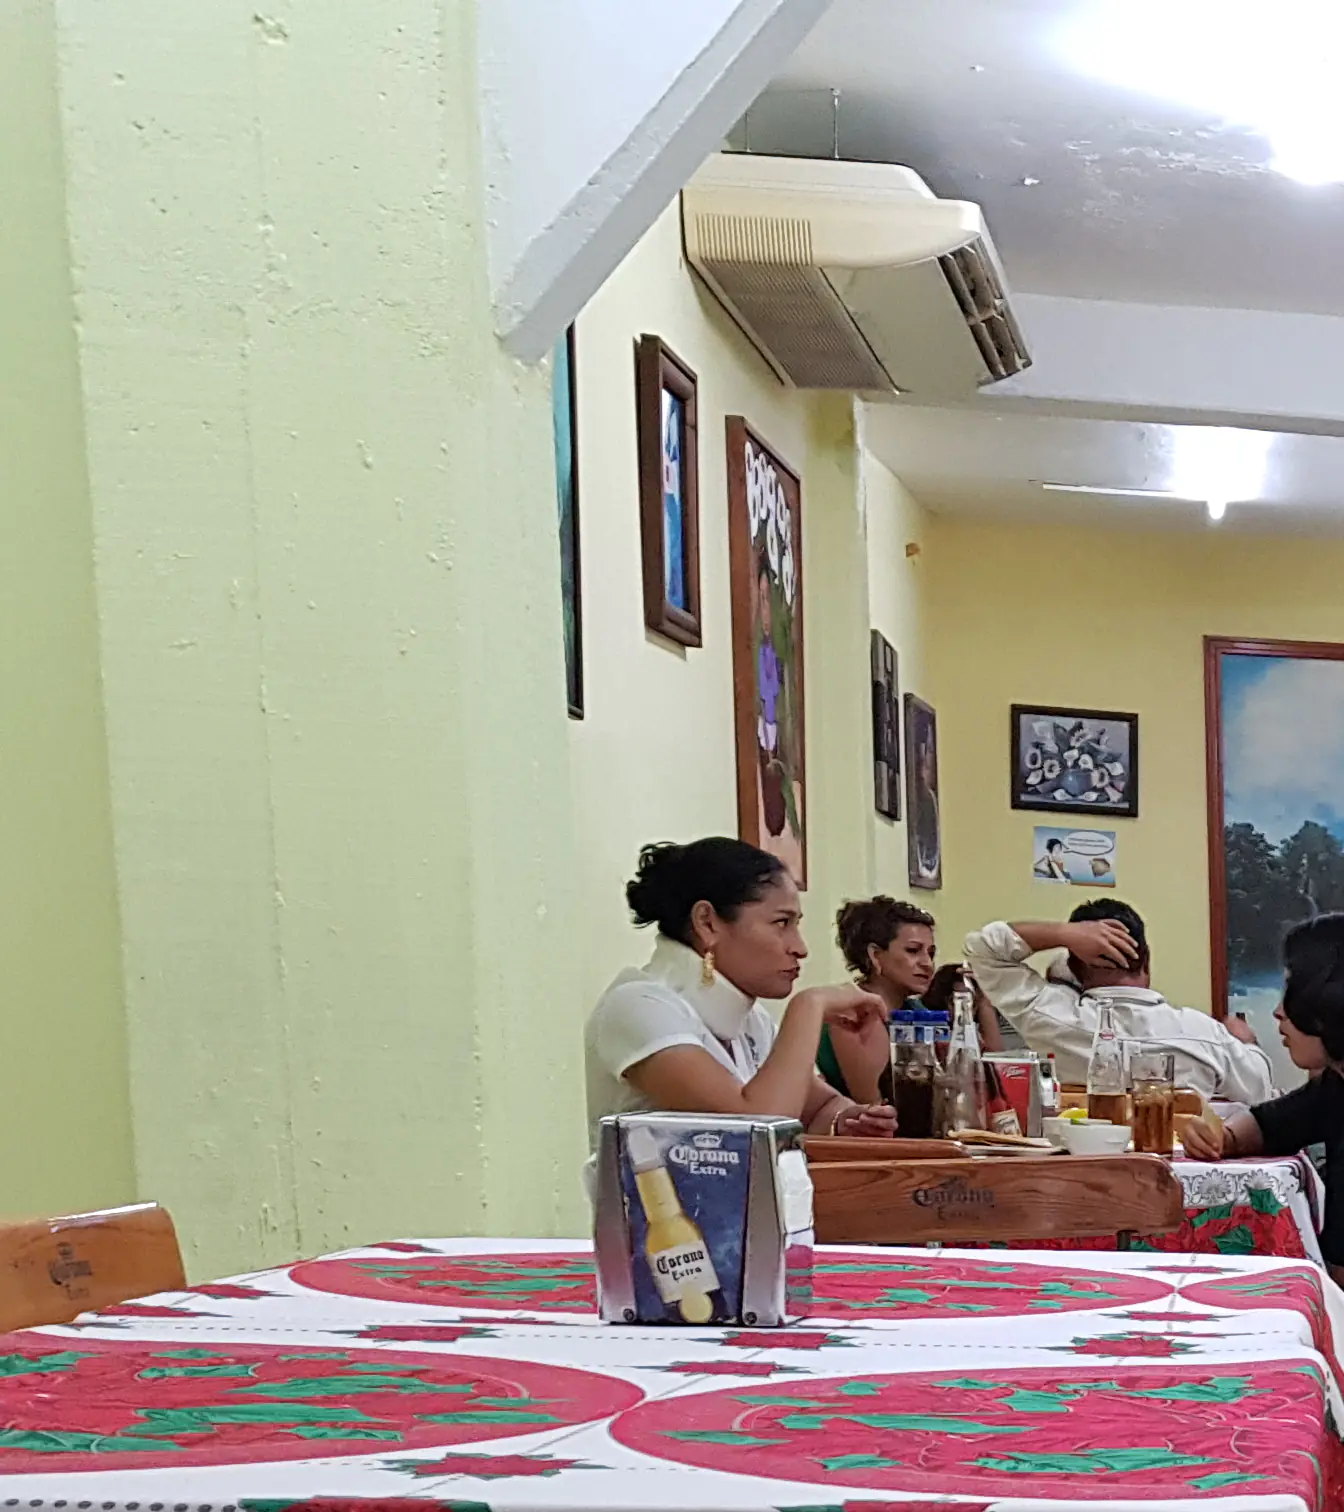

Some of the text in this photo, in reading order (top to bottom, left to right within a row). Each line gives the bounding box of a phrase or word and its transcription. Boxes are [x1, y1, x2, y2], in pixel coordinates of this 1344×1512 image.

[668, 1145, 740, 1165] Corona
[689, 1165, 727, 1176] Extra
[657, 1250, 705, 1275] Corona
[672, 1266, 703, 1282] Extra
